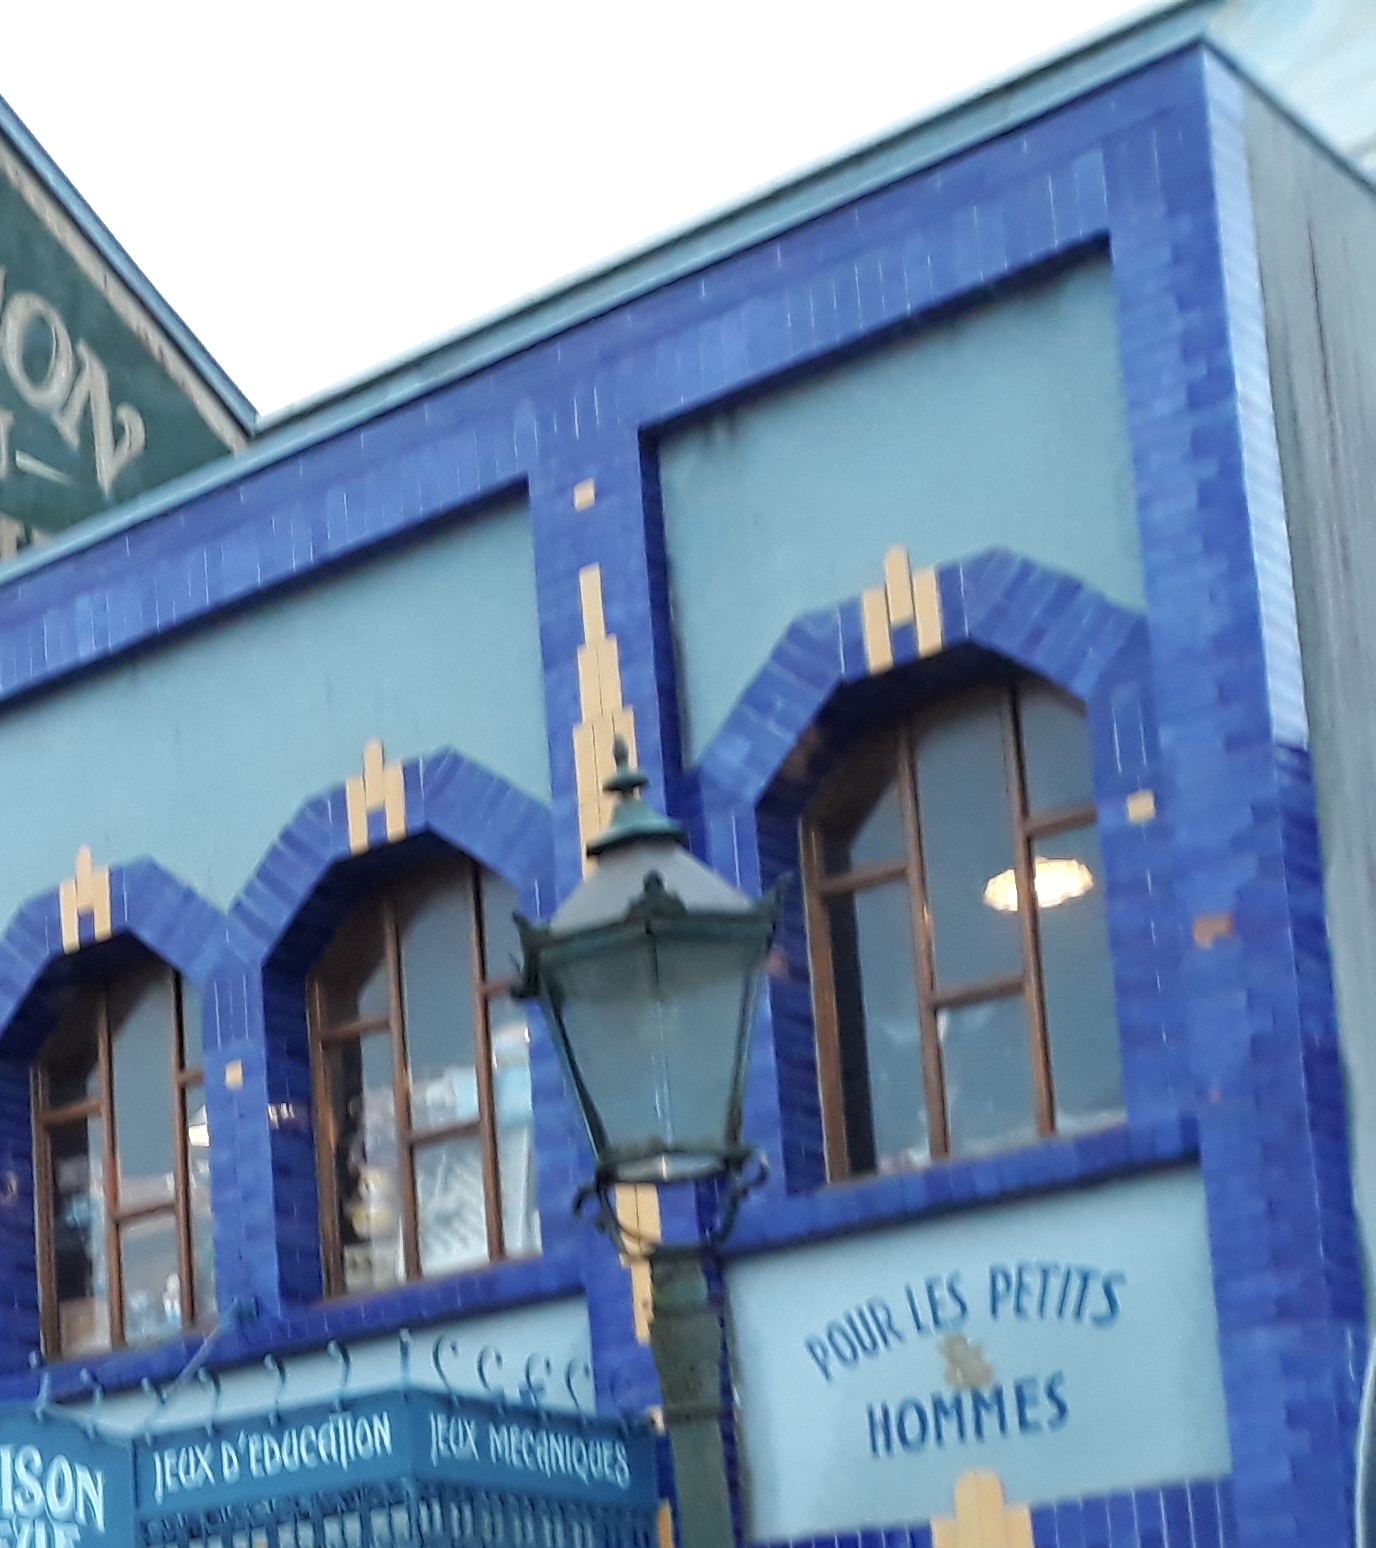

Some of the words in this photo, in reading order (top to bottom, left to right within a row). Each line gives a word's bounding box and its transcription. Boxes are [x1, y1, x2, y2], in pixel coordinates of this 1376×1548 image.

[803, 1297, 905, 1385] POUR
[905, 1267, 970, 1337] LES
[988, 1260, 1128, 1330] PETITS
[430, 1411, 480, 1468] JEUX
[866, 1370, 1071, 1459] HOMMES
[153, 1442, 216, 1507] JEUX
